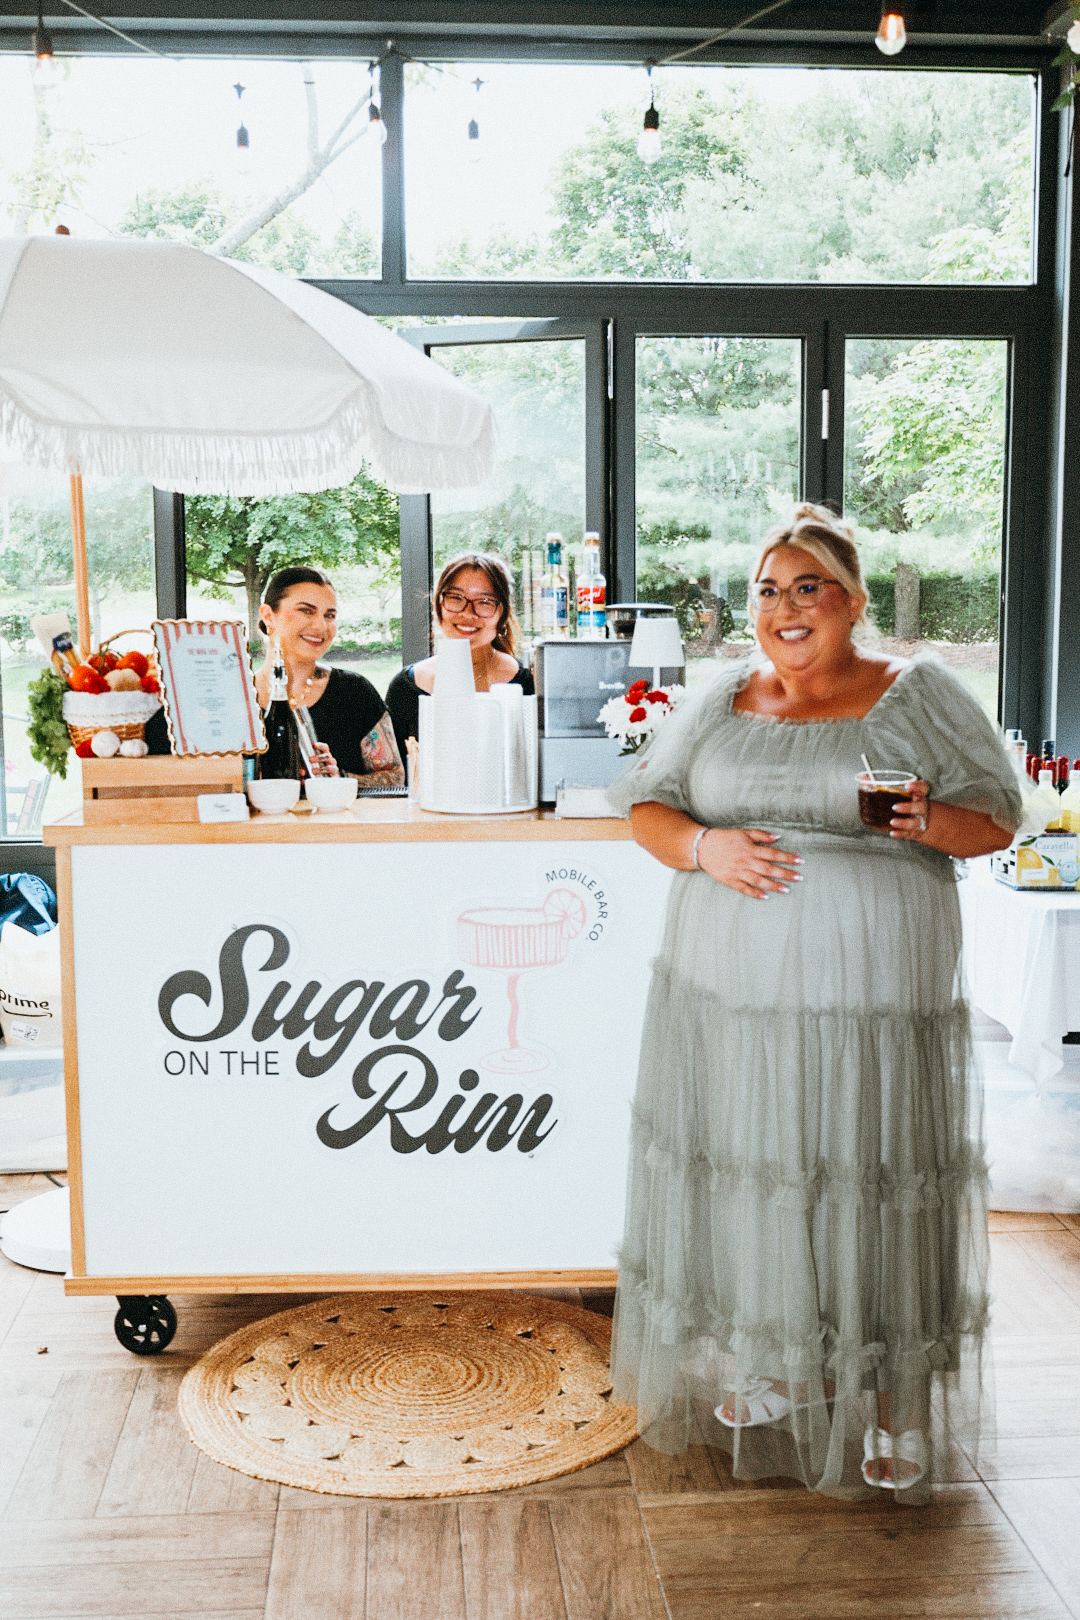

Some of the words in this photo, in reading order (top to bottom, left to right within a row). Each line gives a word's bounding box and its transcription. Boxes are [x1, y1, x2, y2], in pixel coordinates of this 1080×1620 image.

[545, 868, 597, 891] MOBILE
[594, 890, 608, 919] BAR
[158, 924, 482, 1078] Sugar
[164, 1050, 209, 1076] ON
[220, 1050, 280, 1076] THE
[316, 1044, 558, 1155] Rim
